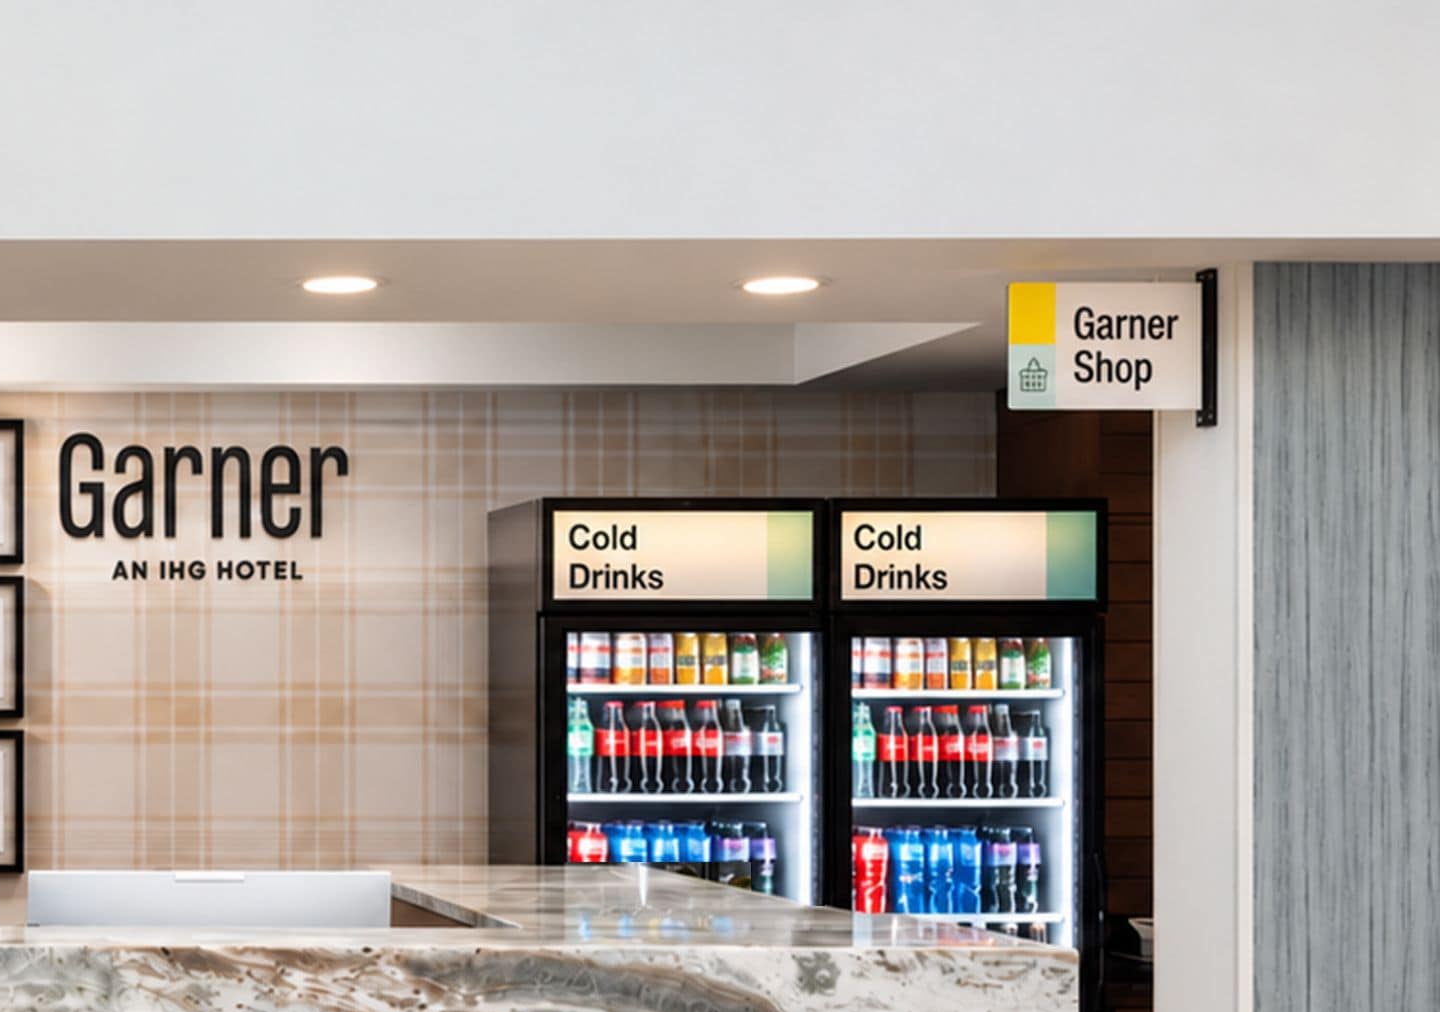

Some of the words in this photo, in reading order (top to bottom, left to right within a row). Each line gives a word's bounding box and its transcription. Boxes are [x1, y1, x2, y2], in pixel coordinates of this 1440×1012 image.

[1074, 306, 1179, 341] Garner
[1074, 349, 1153, 391] Shop
[59, 432, 349, 540] Garner
[569, 524, 638, 551] Cold
[853, 524, 922, 551] Cold
[112, 560, 148, 580] AN
[160, 560, 207, 581] IHG
[217, 560, 303, 581] HOTEL
[569, 563, 664, 590] Drinks
[853, 563, 948, 591] Drinks
